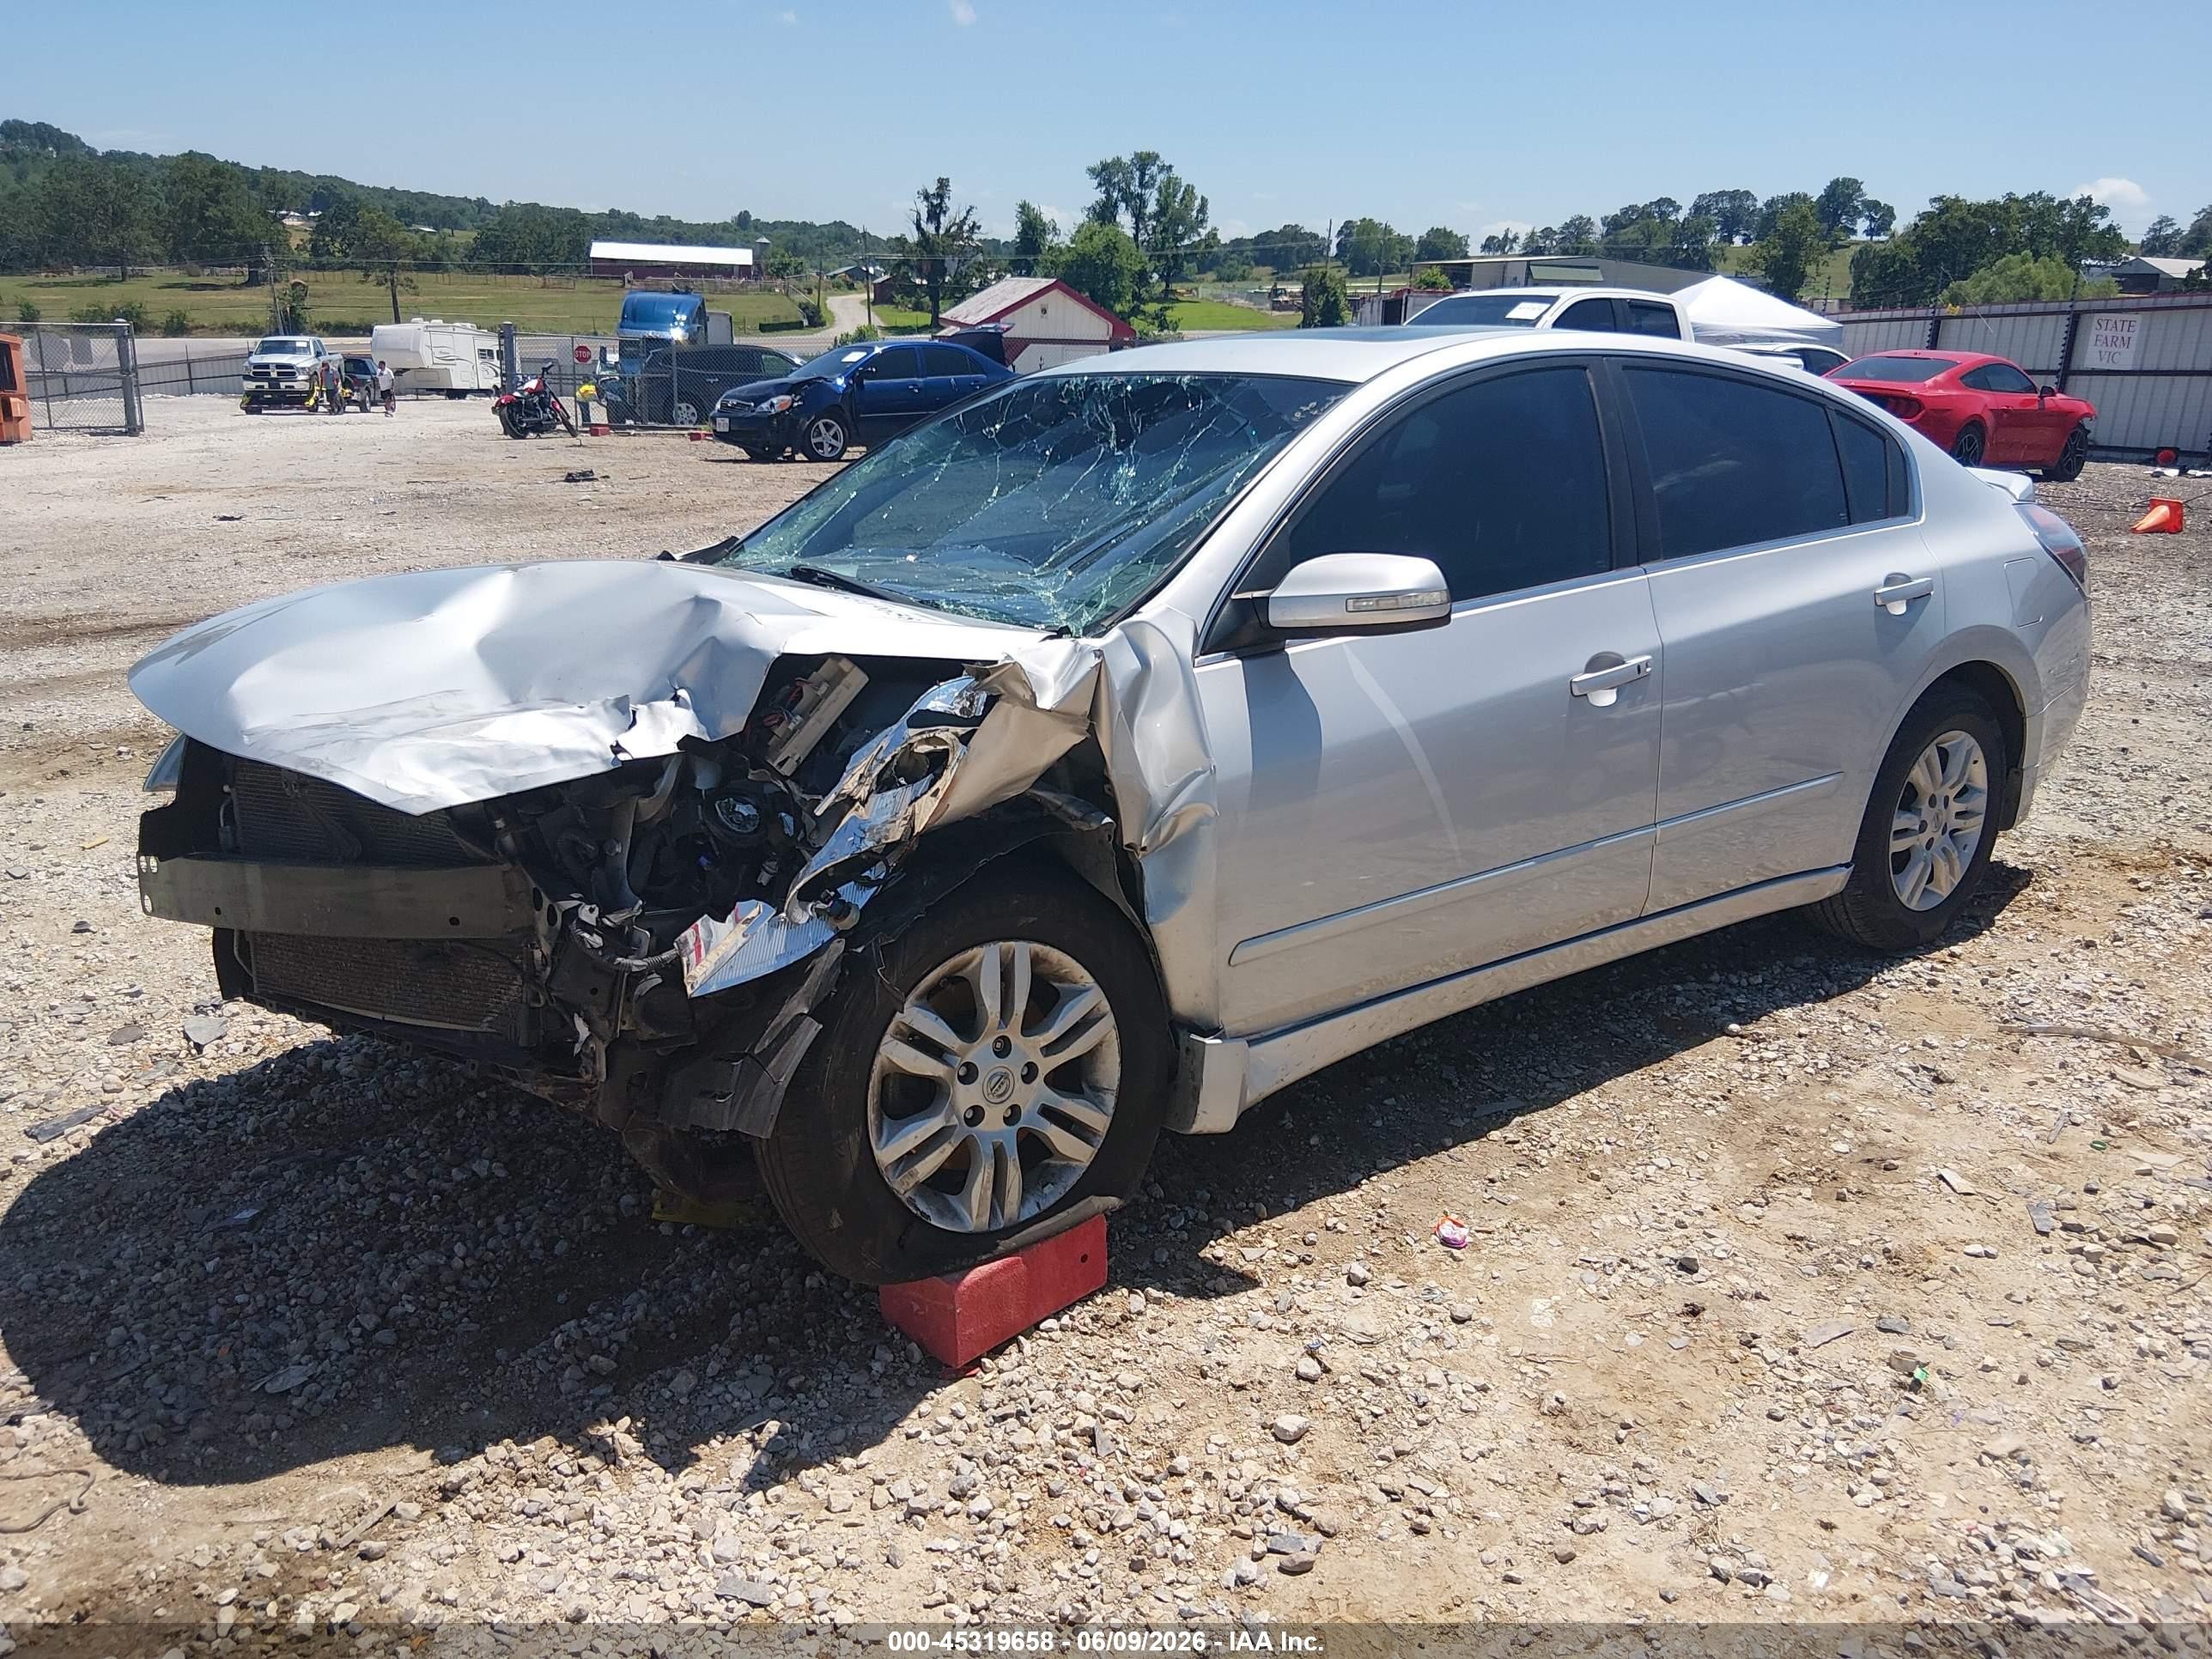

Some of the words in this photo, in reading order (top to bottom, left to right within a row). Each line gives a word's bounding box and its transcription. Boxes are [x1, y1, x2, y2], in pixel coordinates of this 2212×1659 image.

[2095, 318, 2137, 333] STATE
[2094, 334, 2132, 349] FARM
[2098, 349, 2121, 364] VIC
